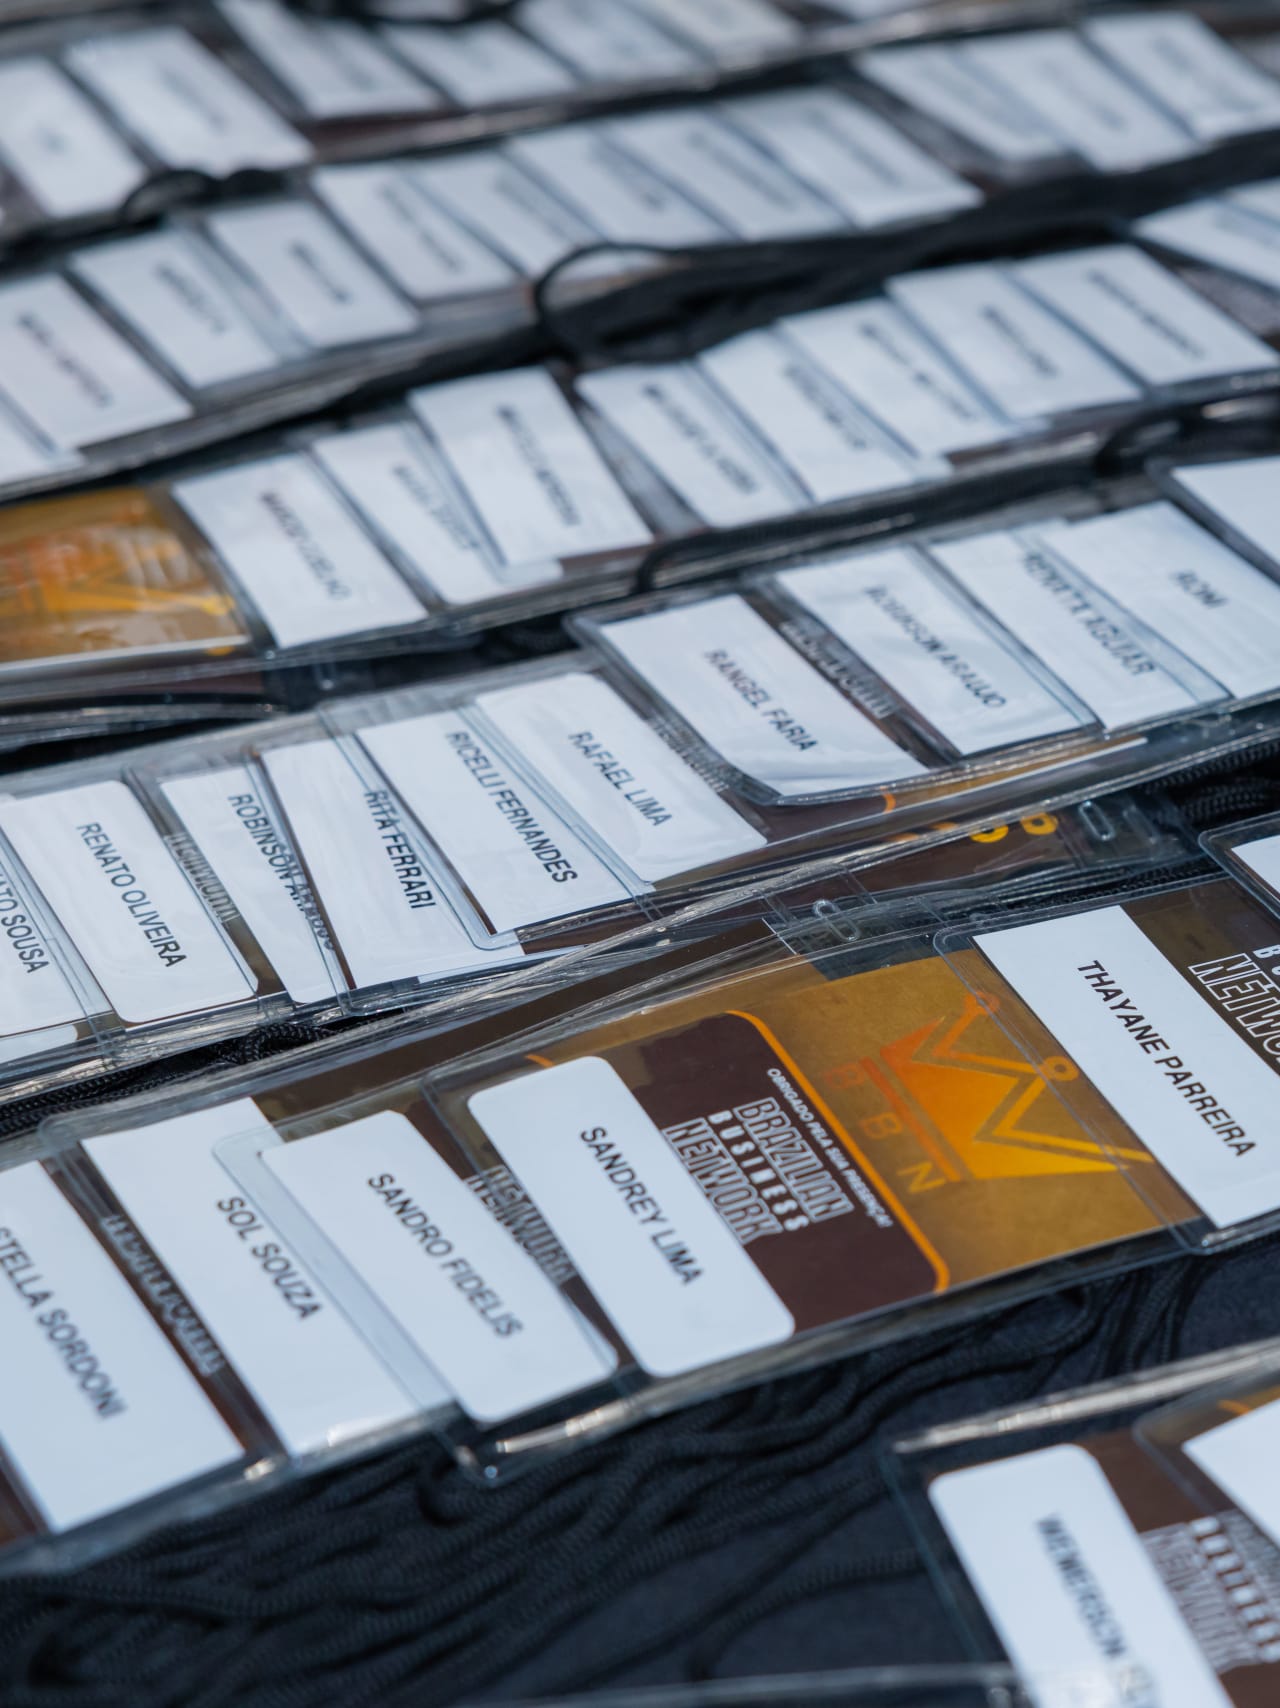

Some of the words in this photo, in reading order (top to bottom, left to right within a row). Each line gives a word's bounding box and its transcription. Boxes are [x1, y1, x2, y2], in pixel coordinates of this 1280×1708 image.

[568, 731, 634, 790] RAFAEL
[624, 787, 673, 828] LIMA
[761, 707, 819, 752] FARIA
[365, 790, 403, 832] RITA
[381, 830, 437, 909] FERRARI
[446, 732, 506, 790] RICELLI
[489, 788, 578, 884] FERNANDES
[1, 914, 50, 973] SOUSA
[78, 822, 136, 889] RENATO
[120, 889, 188, 967] OLIVEIRA
[1076, 961, 1170, 1054] THAYANE
[1155, 1056, 1257, 1157] PARREIRA
[581, 1126, 667, 1223] SANDREY
[652, 1225, 704, 1285] LIMA
[662, 1117, 784, 1245] NETWORK
[708, 1110, 810, 1231] BUSINESS
[734, 1097, 855, 1223] BRAZILIAN
[217, 1196, 261, 1241] SOL
[250, 1241, 322, 1320] SOUZA
[367, 1172, 455, 1259] SANDRO
[440, 1258, 524, 1339] FIDELIS
